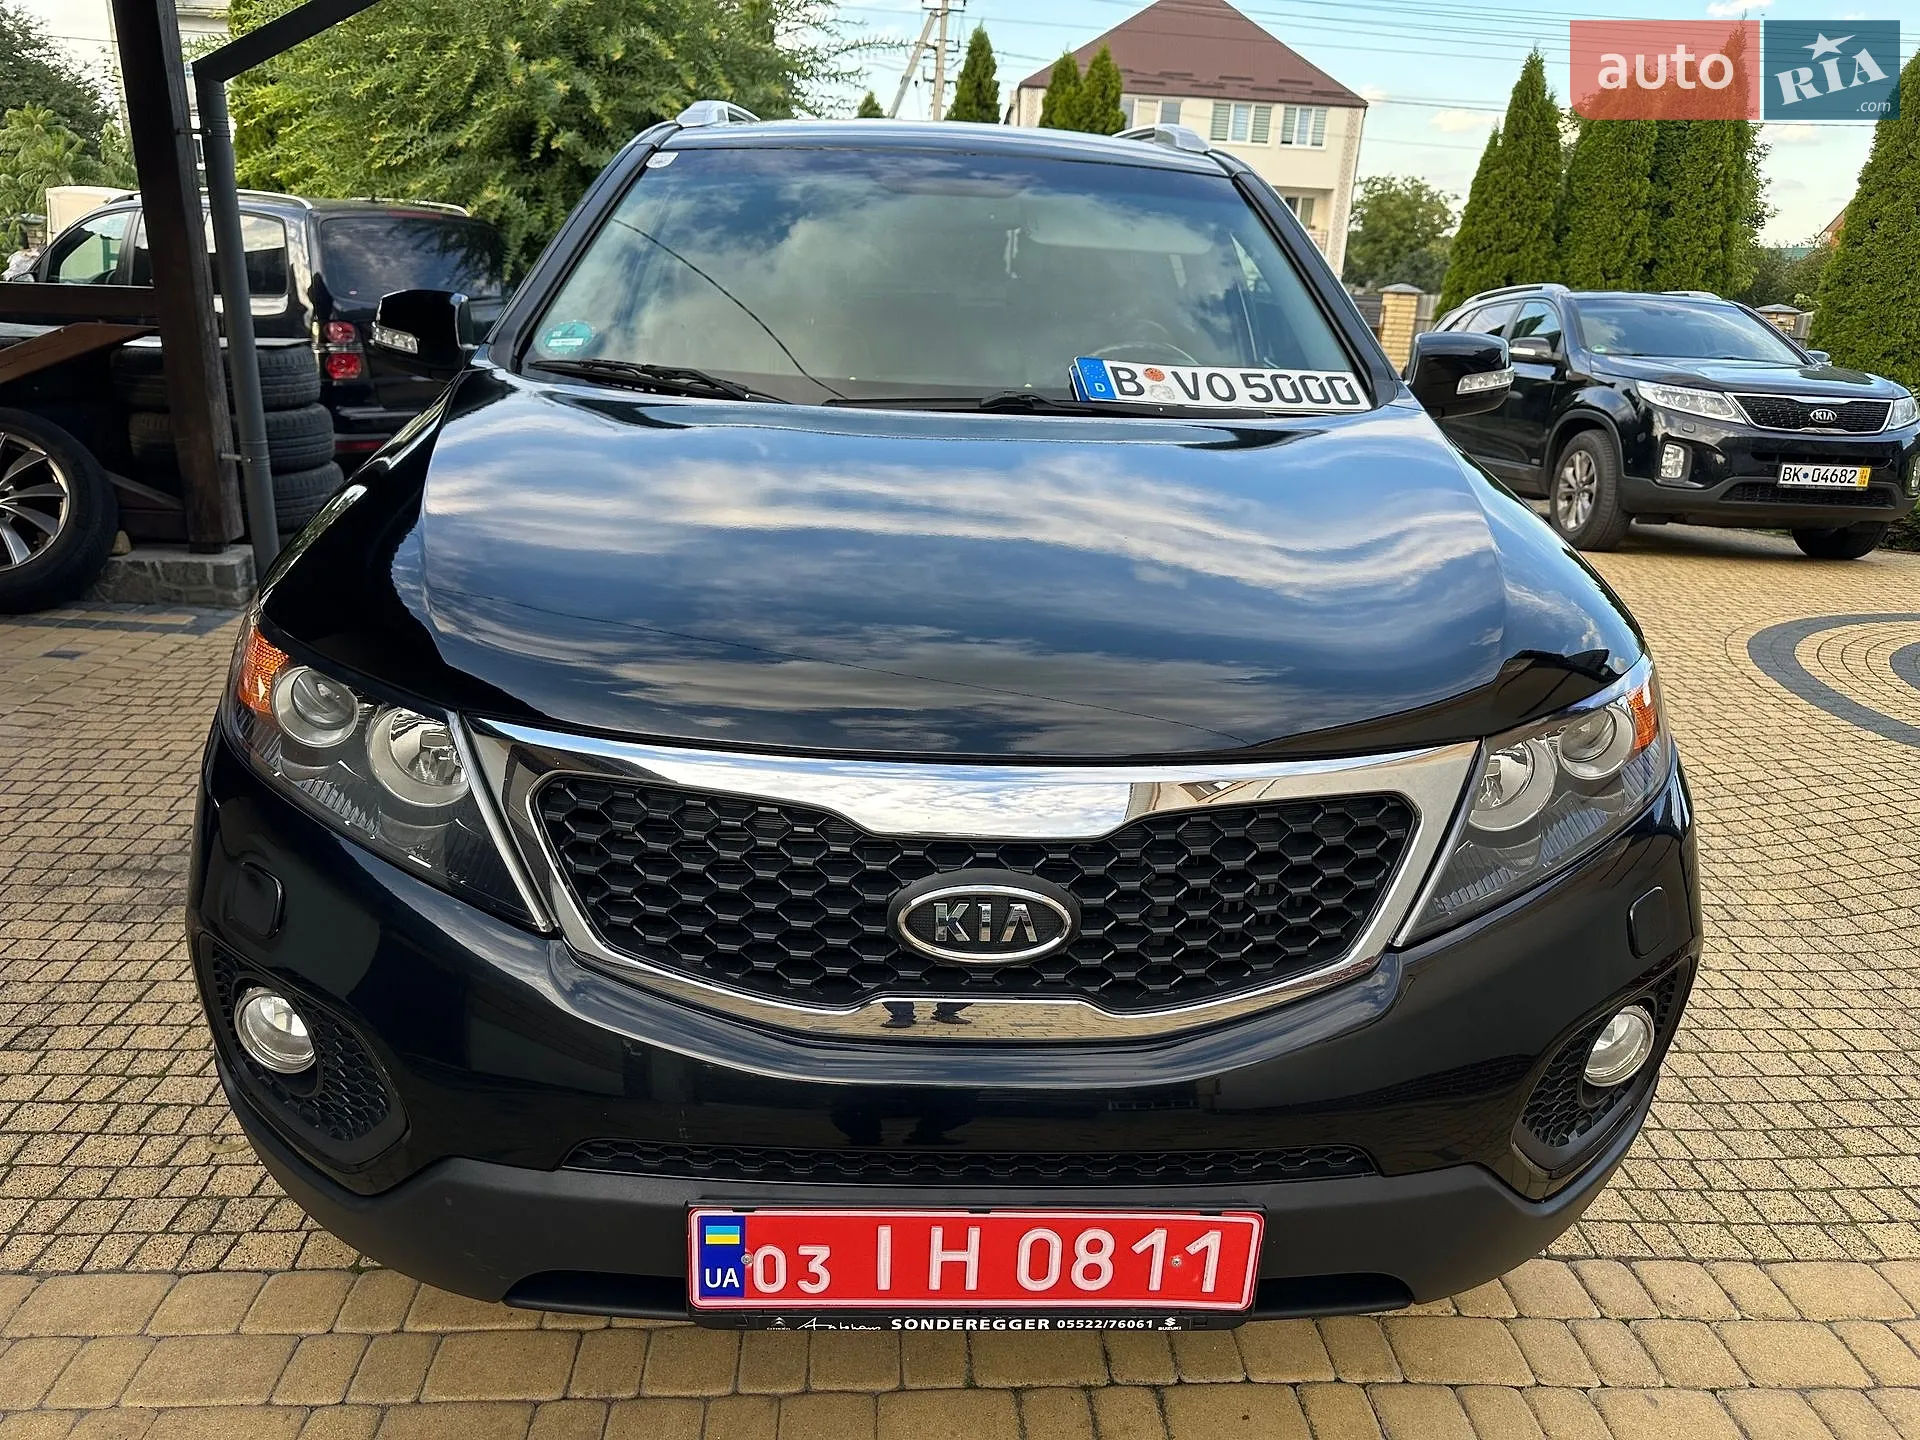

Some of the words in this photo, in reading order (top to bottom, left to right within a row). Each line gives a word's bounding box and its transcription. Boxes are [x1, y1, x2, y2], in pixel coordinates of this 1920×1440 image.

[1094, 382, 1106, 393] D
[1109, 366, 1145, 397] B
[1815, 411, 1834, 421] KIA
[1811, 468, 1858, 484] 04682
[933, 902, 1038, 942] KIA
[752, 1245, 831, 1294] 03
[1016, 1228, 1222, 1293] 0811
[705, 1267, 740, 1288] UA
[891, 1318, 1050, 1330] SONDEREGGER
[1056, 1319, 1153, 1329] 05522/76061
